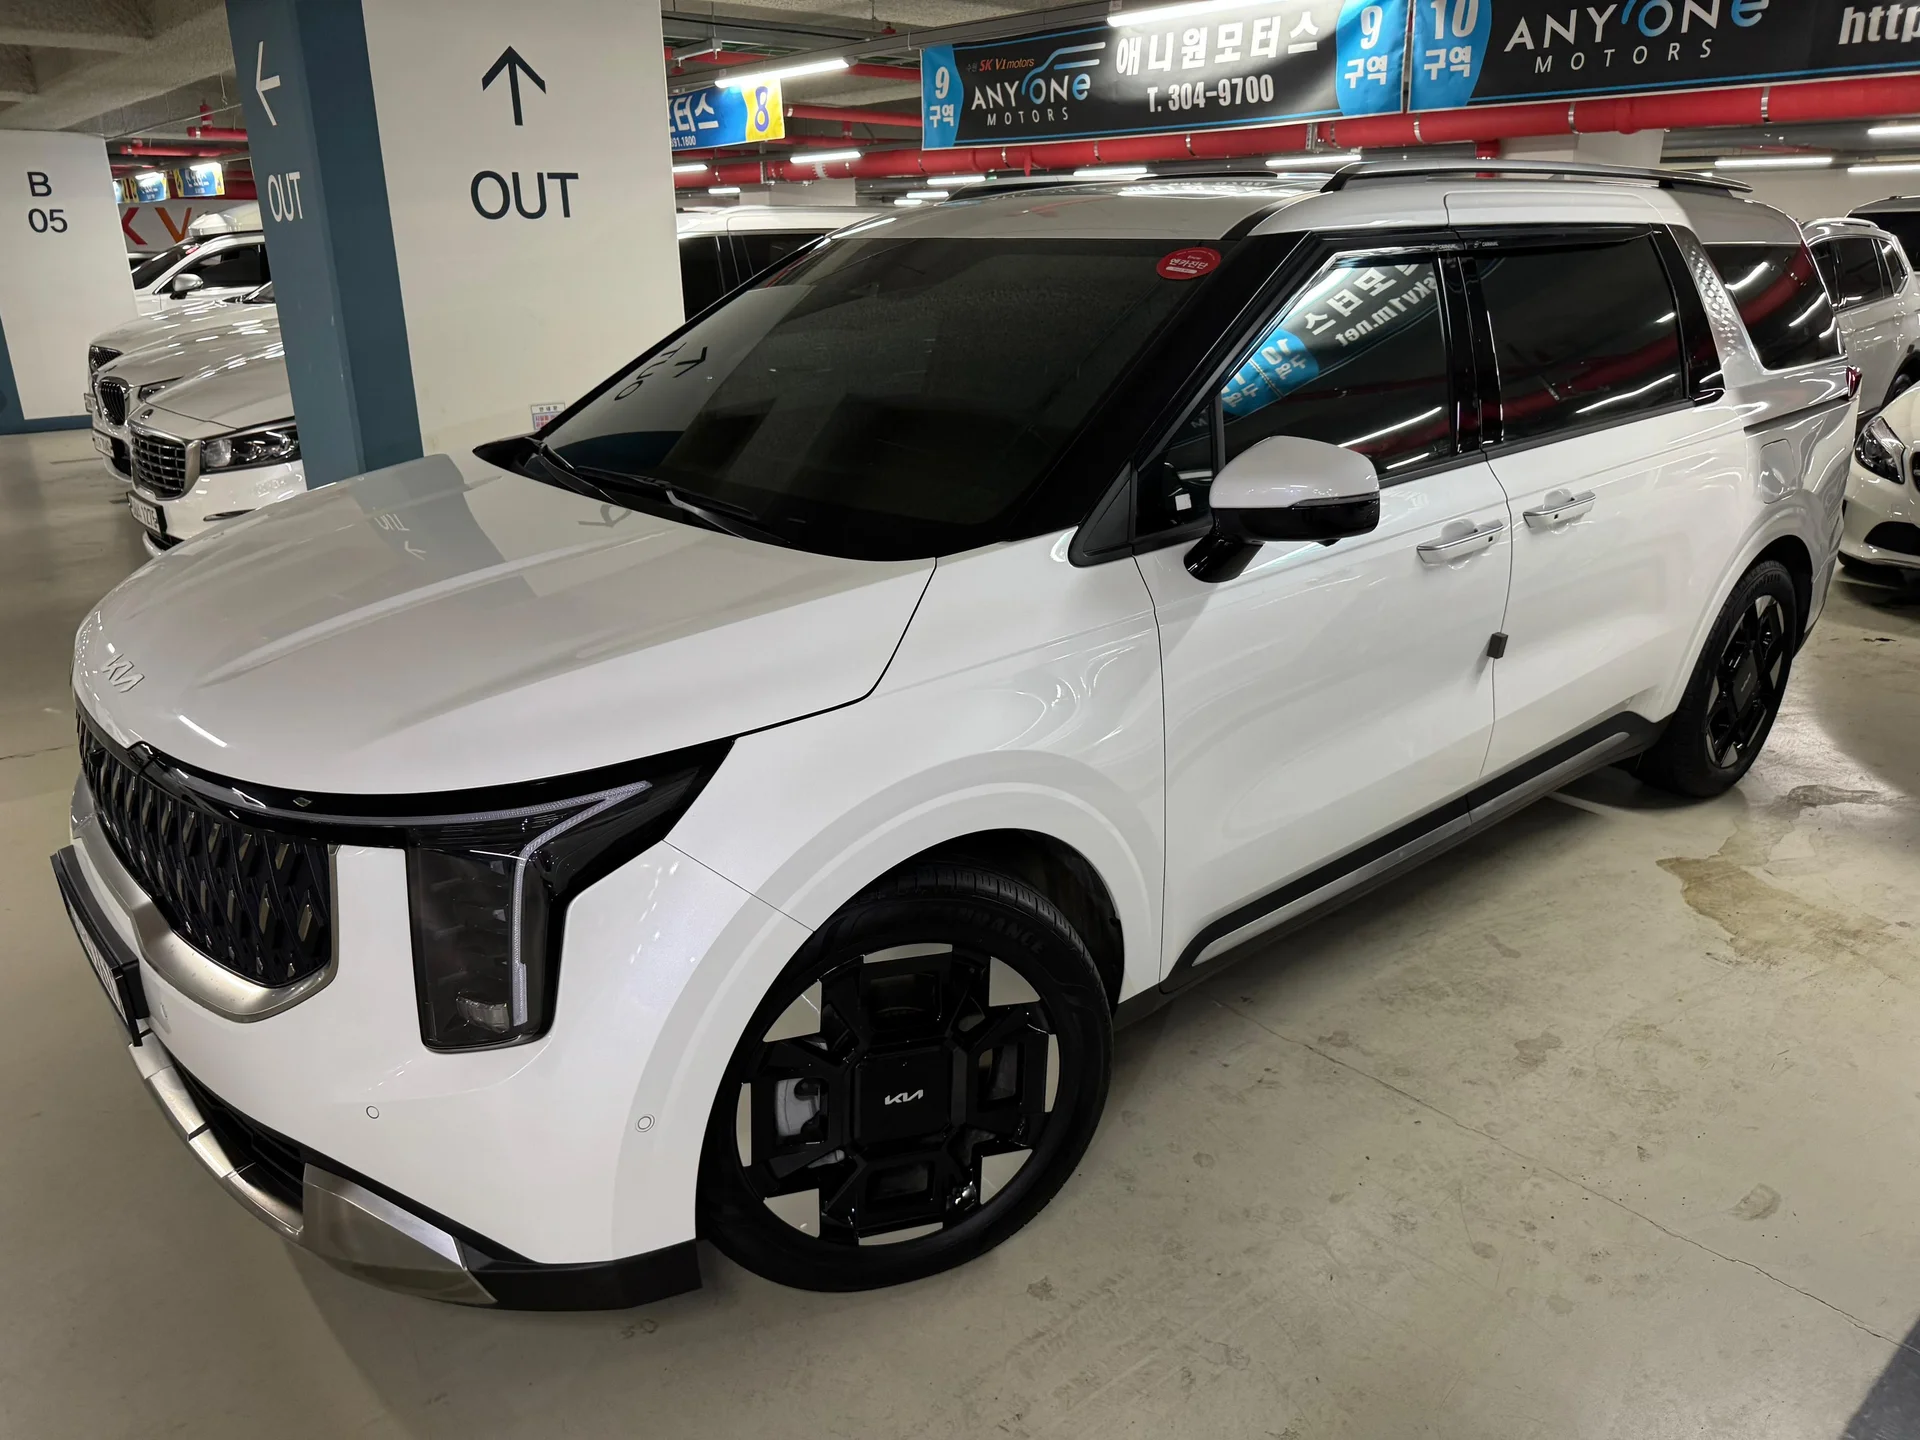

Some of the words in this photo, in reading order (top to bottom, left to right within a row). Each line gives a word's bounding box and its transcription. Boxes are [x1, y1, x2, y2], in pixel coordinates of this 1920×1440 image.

[1360, 5, 1383, 50] 9
[1431, 0, 1479, 40] 10
[979, 59, 994, 72] SK
[1344, 55, 1388, 89] 구역
[1424, 46, 1472, 81] 구역
[1534, 39, 1712, 74] MOTORS
[935, 66, 950, 99] 9
[1147, 87, 1162, 113] T.
[1168, 74, 1275, 112] 304-9700
[754, 86, 769, 132] 8
[929, 103, 955, 128] 구역
[987, 107, 1069, 126] MOTORS
[27, 172, 52, 197] B
[267, 171, 303, 222] OUT
[471, 170, 579, 220] OUT
[28, 208, 68, 233] 05
[884, 1089, 924, 1105] KIA
